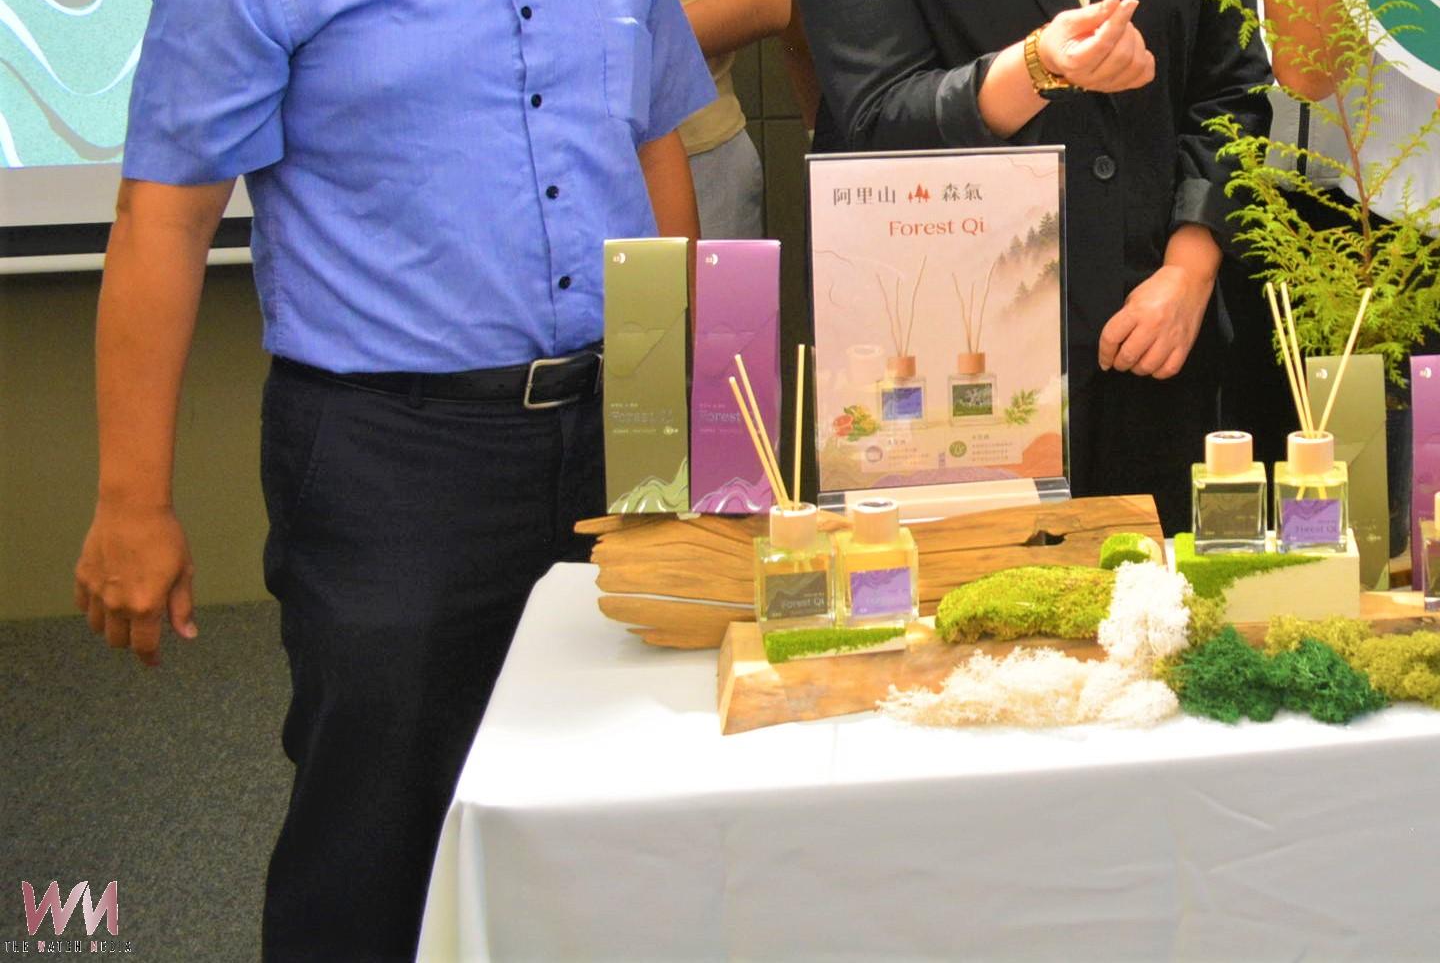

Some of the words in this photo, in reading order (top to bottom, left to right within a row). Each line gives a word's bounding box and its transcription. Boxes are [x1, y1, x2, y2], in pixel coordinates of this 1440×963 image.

[833, 185, 897, 206] 阿里山
[942, 182, 983, 203] 森氣
[889, 218, 954, 237] Forest
[961, 216, 985, 235] Qi
